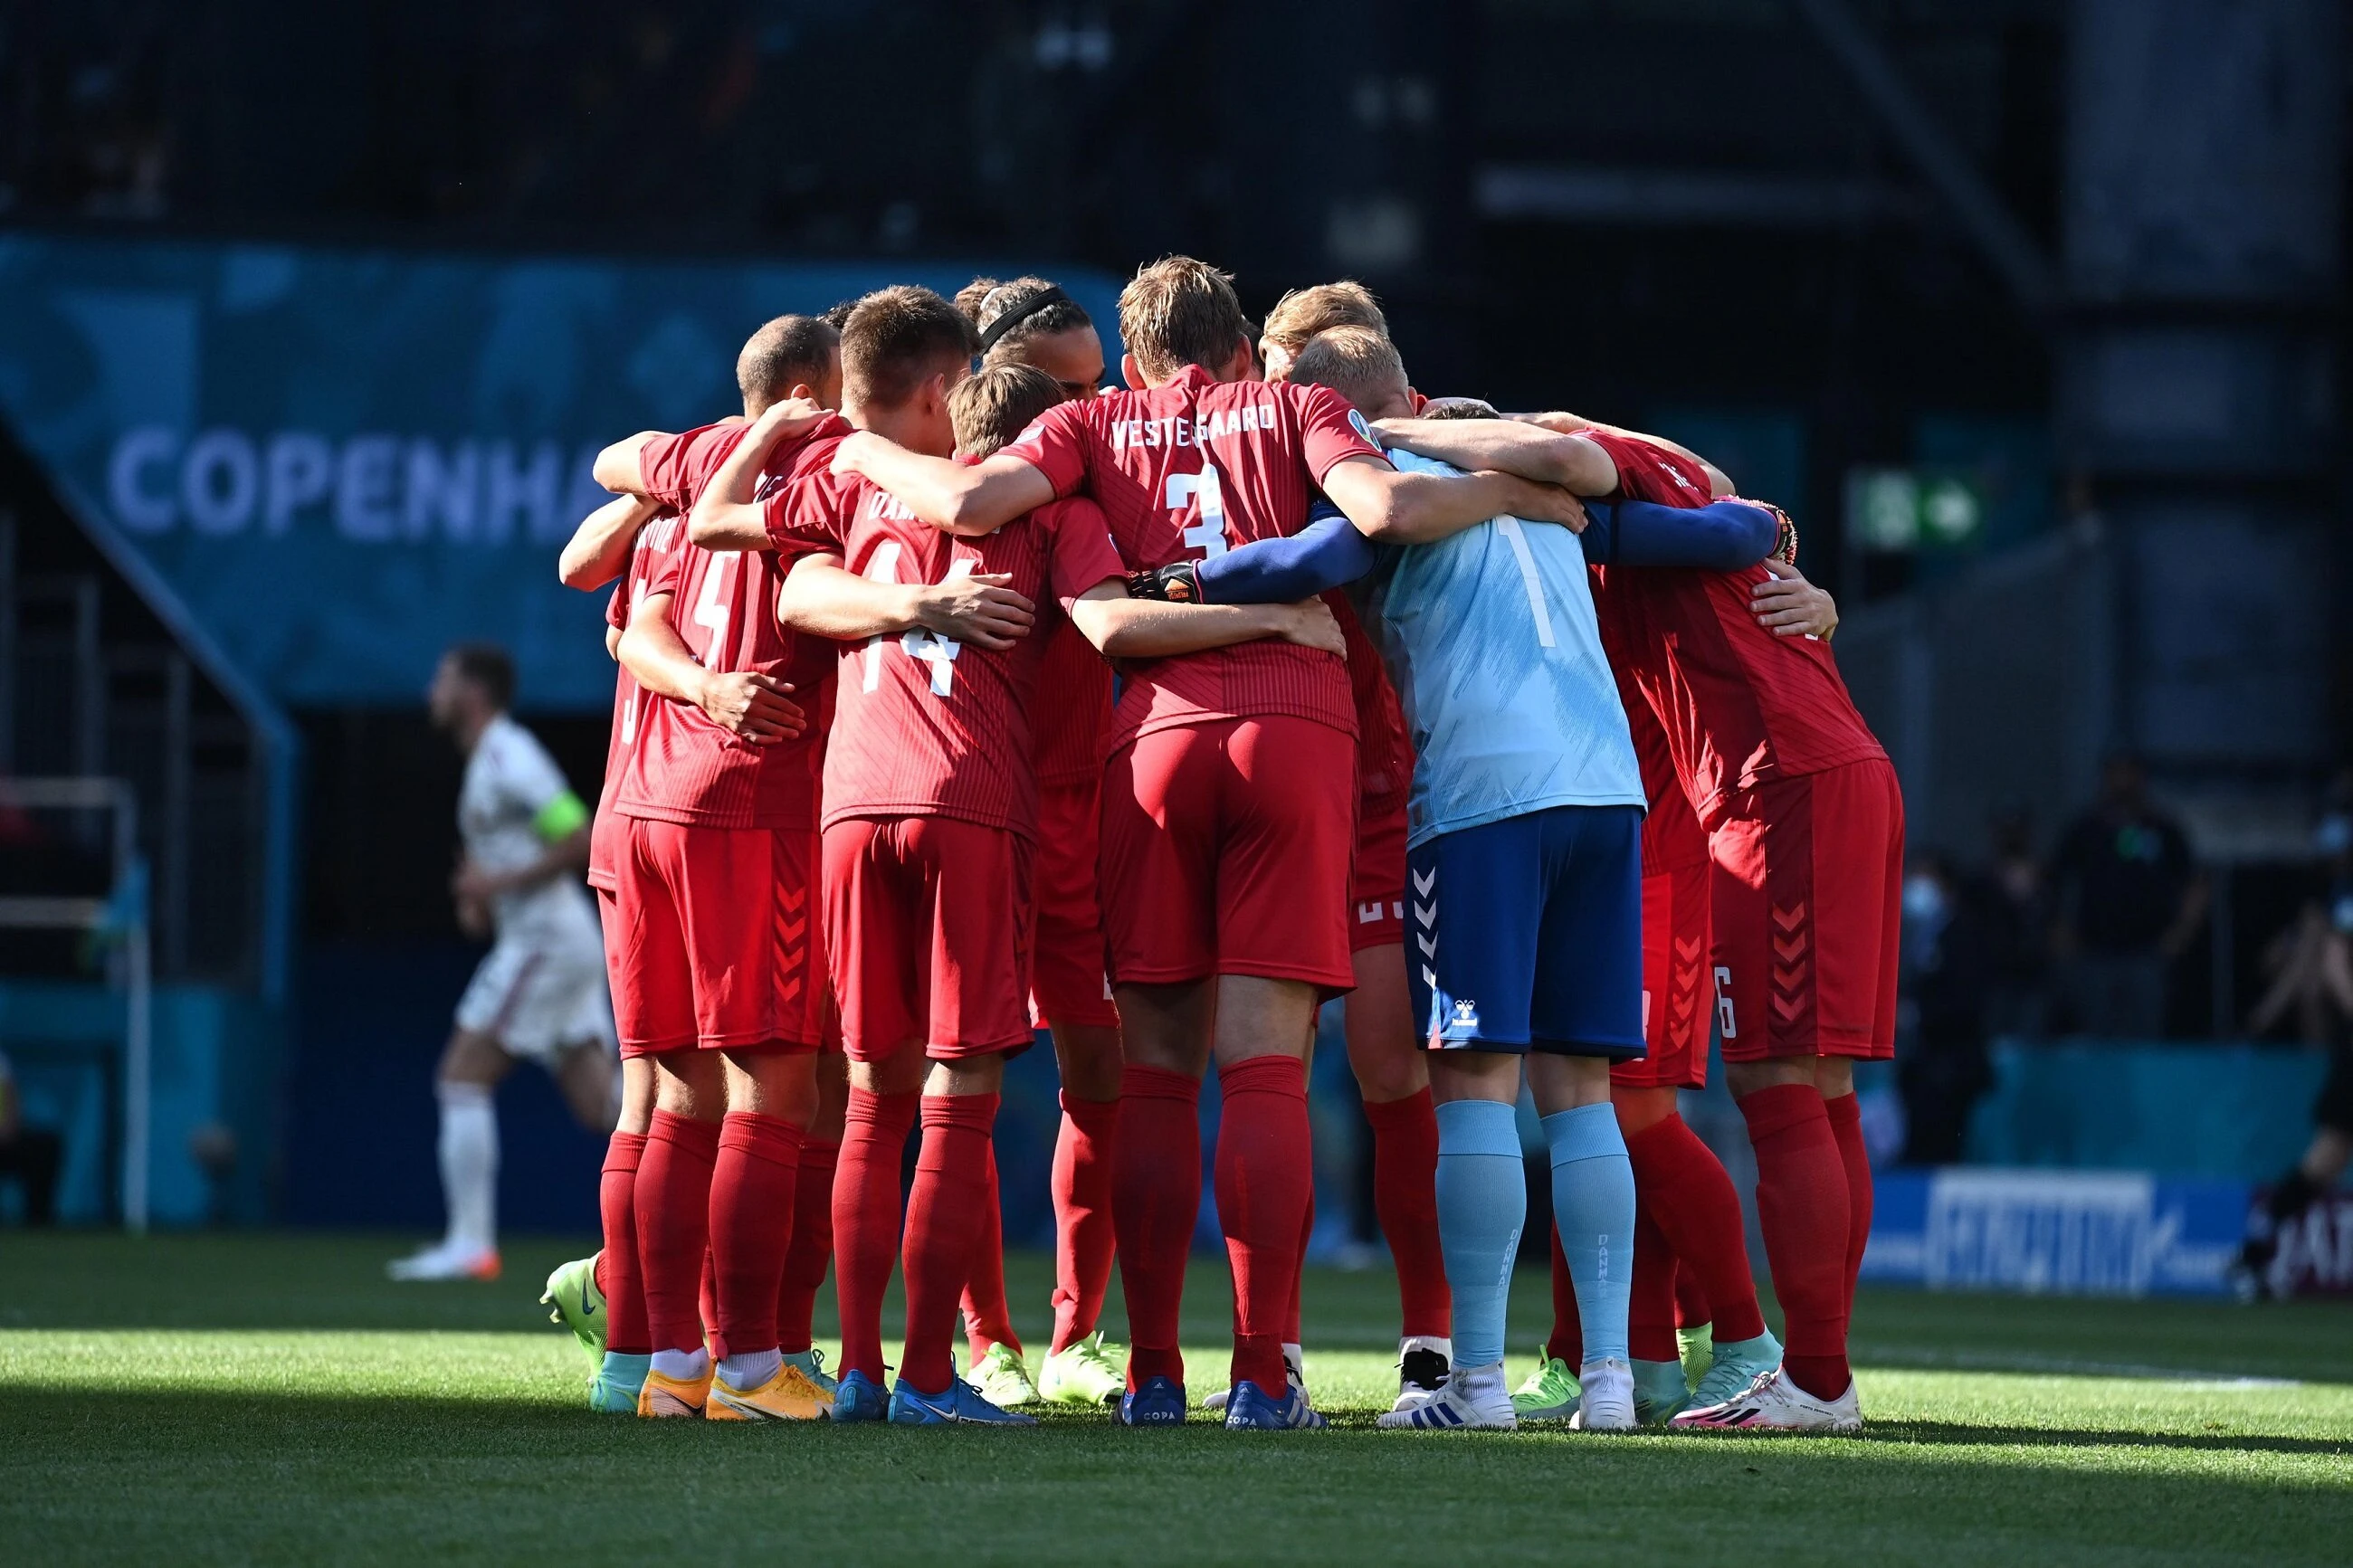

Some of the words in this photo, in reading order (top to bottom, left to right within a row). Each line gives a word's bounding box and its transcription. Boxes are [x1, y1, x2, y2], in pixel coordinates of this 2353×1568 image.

[1166, 462, 1228, 560] 3
[1496, 513, 1557, 647] 1
[1714, 966, 1737, 1039] 6
[1143, 1411, 1176, 1421] COPA
[1227, 1416, 1257, 1426] COPA
